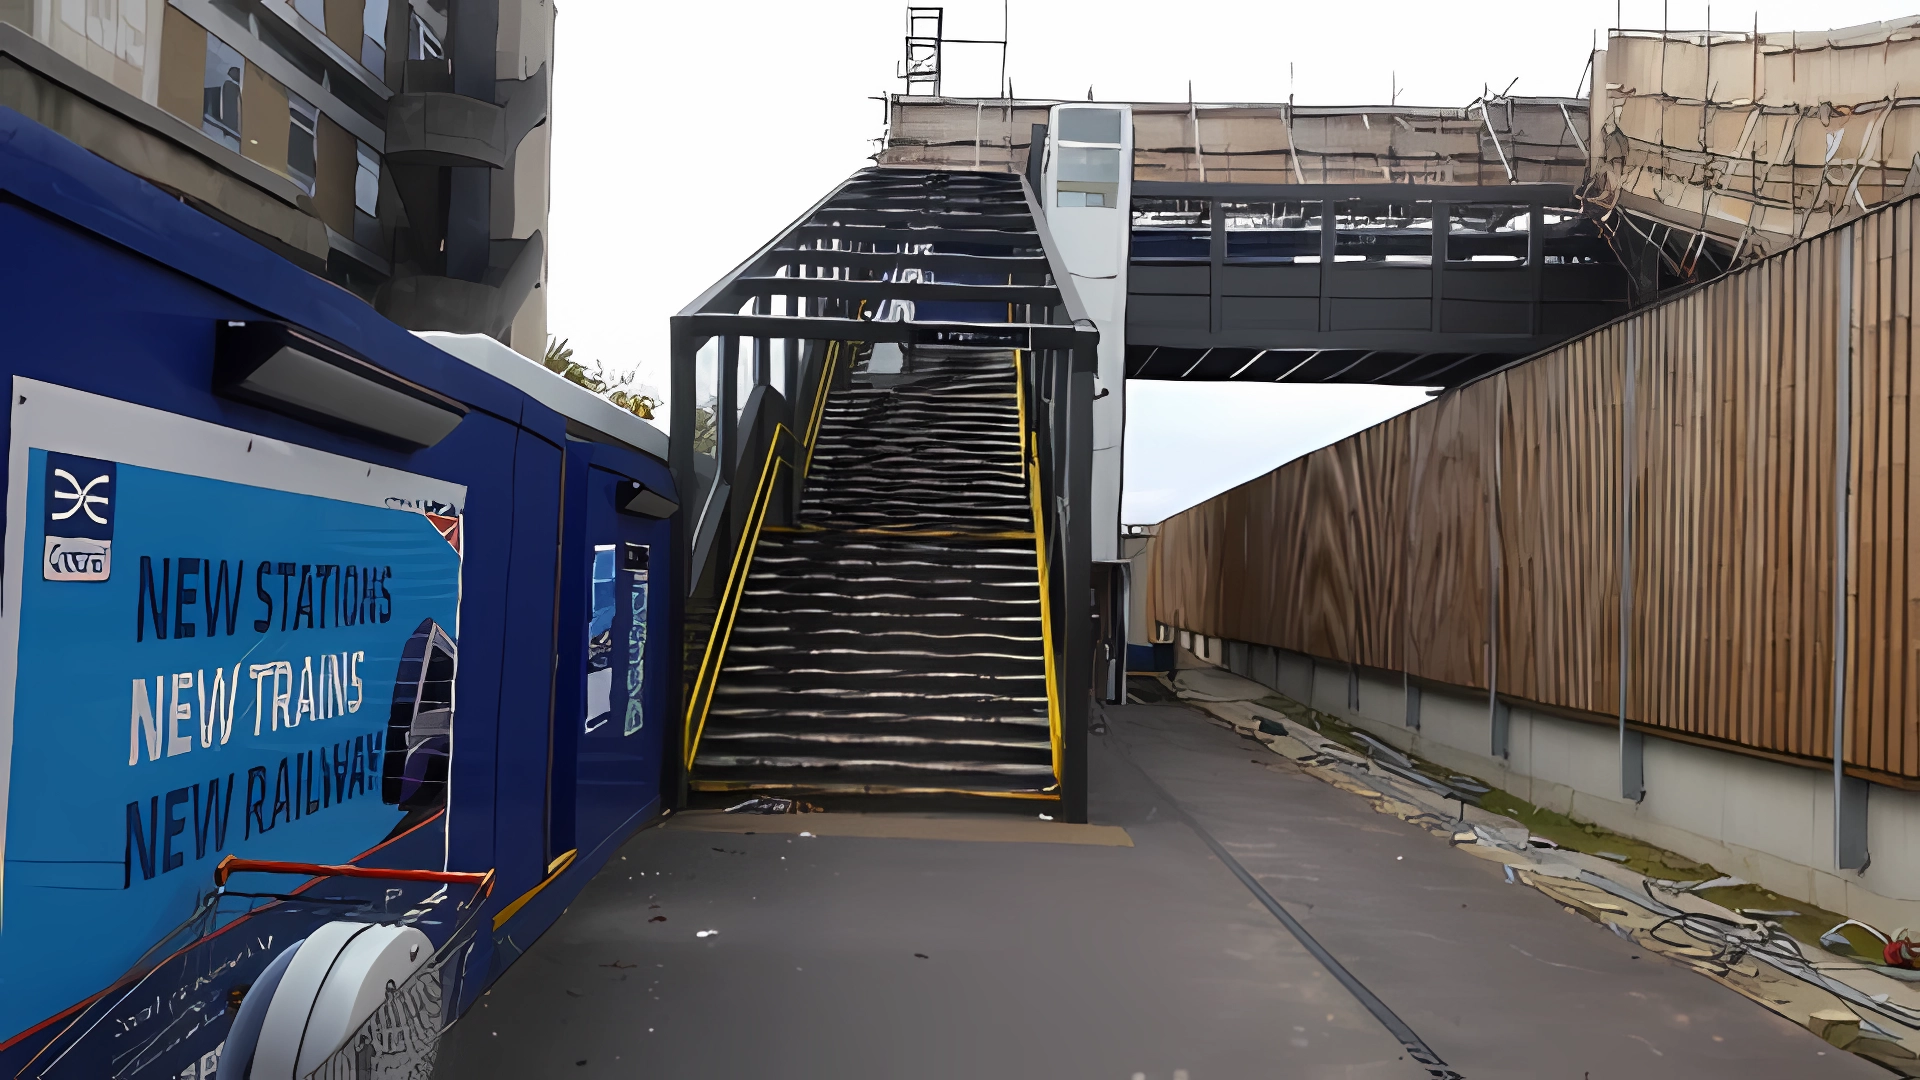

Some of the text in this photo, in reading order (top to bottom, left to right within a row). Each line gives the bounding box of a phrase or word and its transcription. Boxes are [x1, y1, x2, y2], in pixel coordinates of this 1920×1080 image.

[137, 555, 244, 643] NEW
[128, 650, 364, 766] NEW TRAINS
[123, 772, 235, 890] NEW
